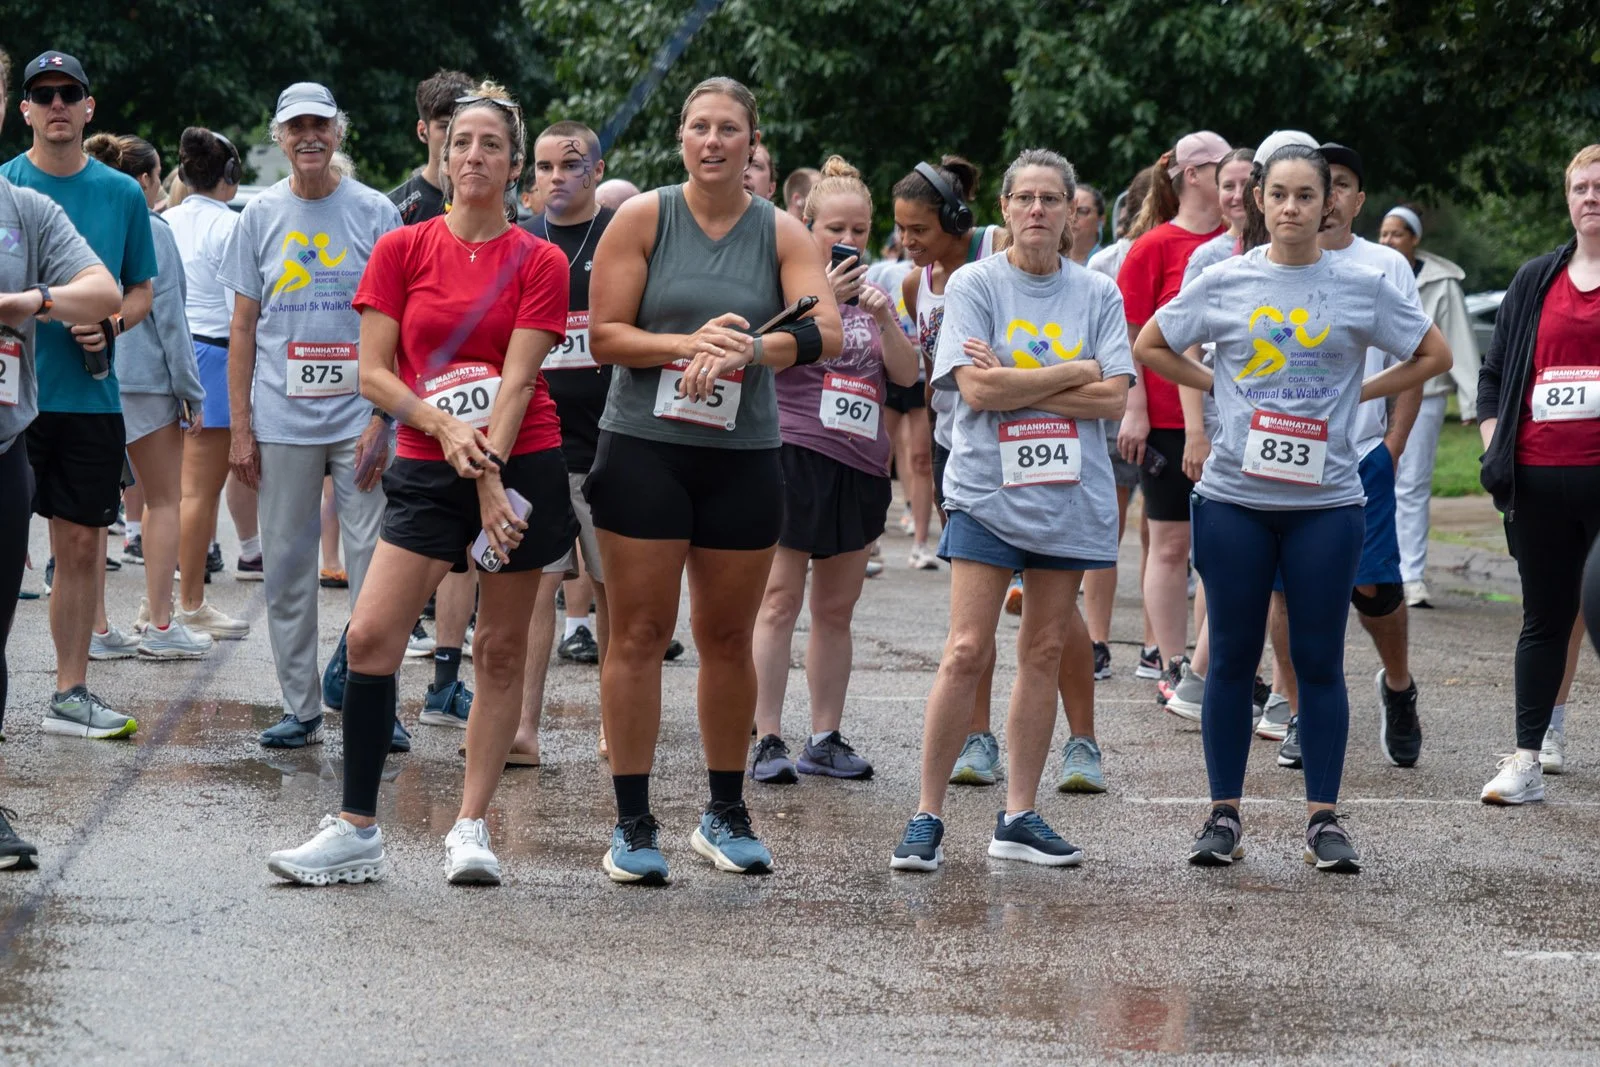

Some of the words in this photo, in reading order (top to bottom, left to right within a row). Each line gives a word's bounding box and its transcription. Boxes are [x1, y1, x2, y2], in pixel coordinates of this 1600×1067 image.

[278, 302, 307, 312] Annual
[309, 301, 320, 311] 5k
[301, 365, 343, 384] 875
[435, 366, 488, 383] MANHATTAN
[1552, 369, 1600, 377] MANHATTAN
[436, 387, 490, 416] 820
[1245, 387, 1279, 399] Annual
[1281, 387, 1293, 399] 5k
[1546, 386, 1586, 406] 821
[835, 397, 872, 422] 967
[1020, 423, 1070, 431] MANHATTAN
[1270, 417, 1322, 432] MANHATTAN
[1017, 443, 1069, 468] 894
[1260, 438, 1310, 466] 833
